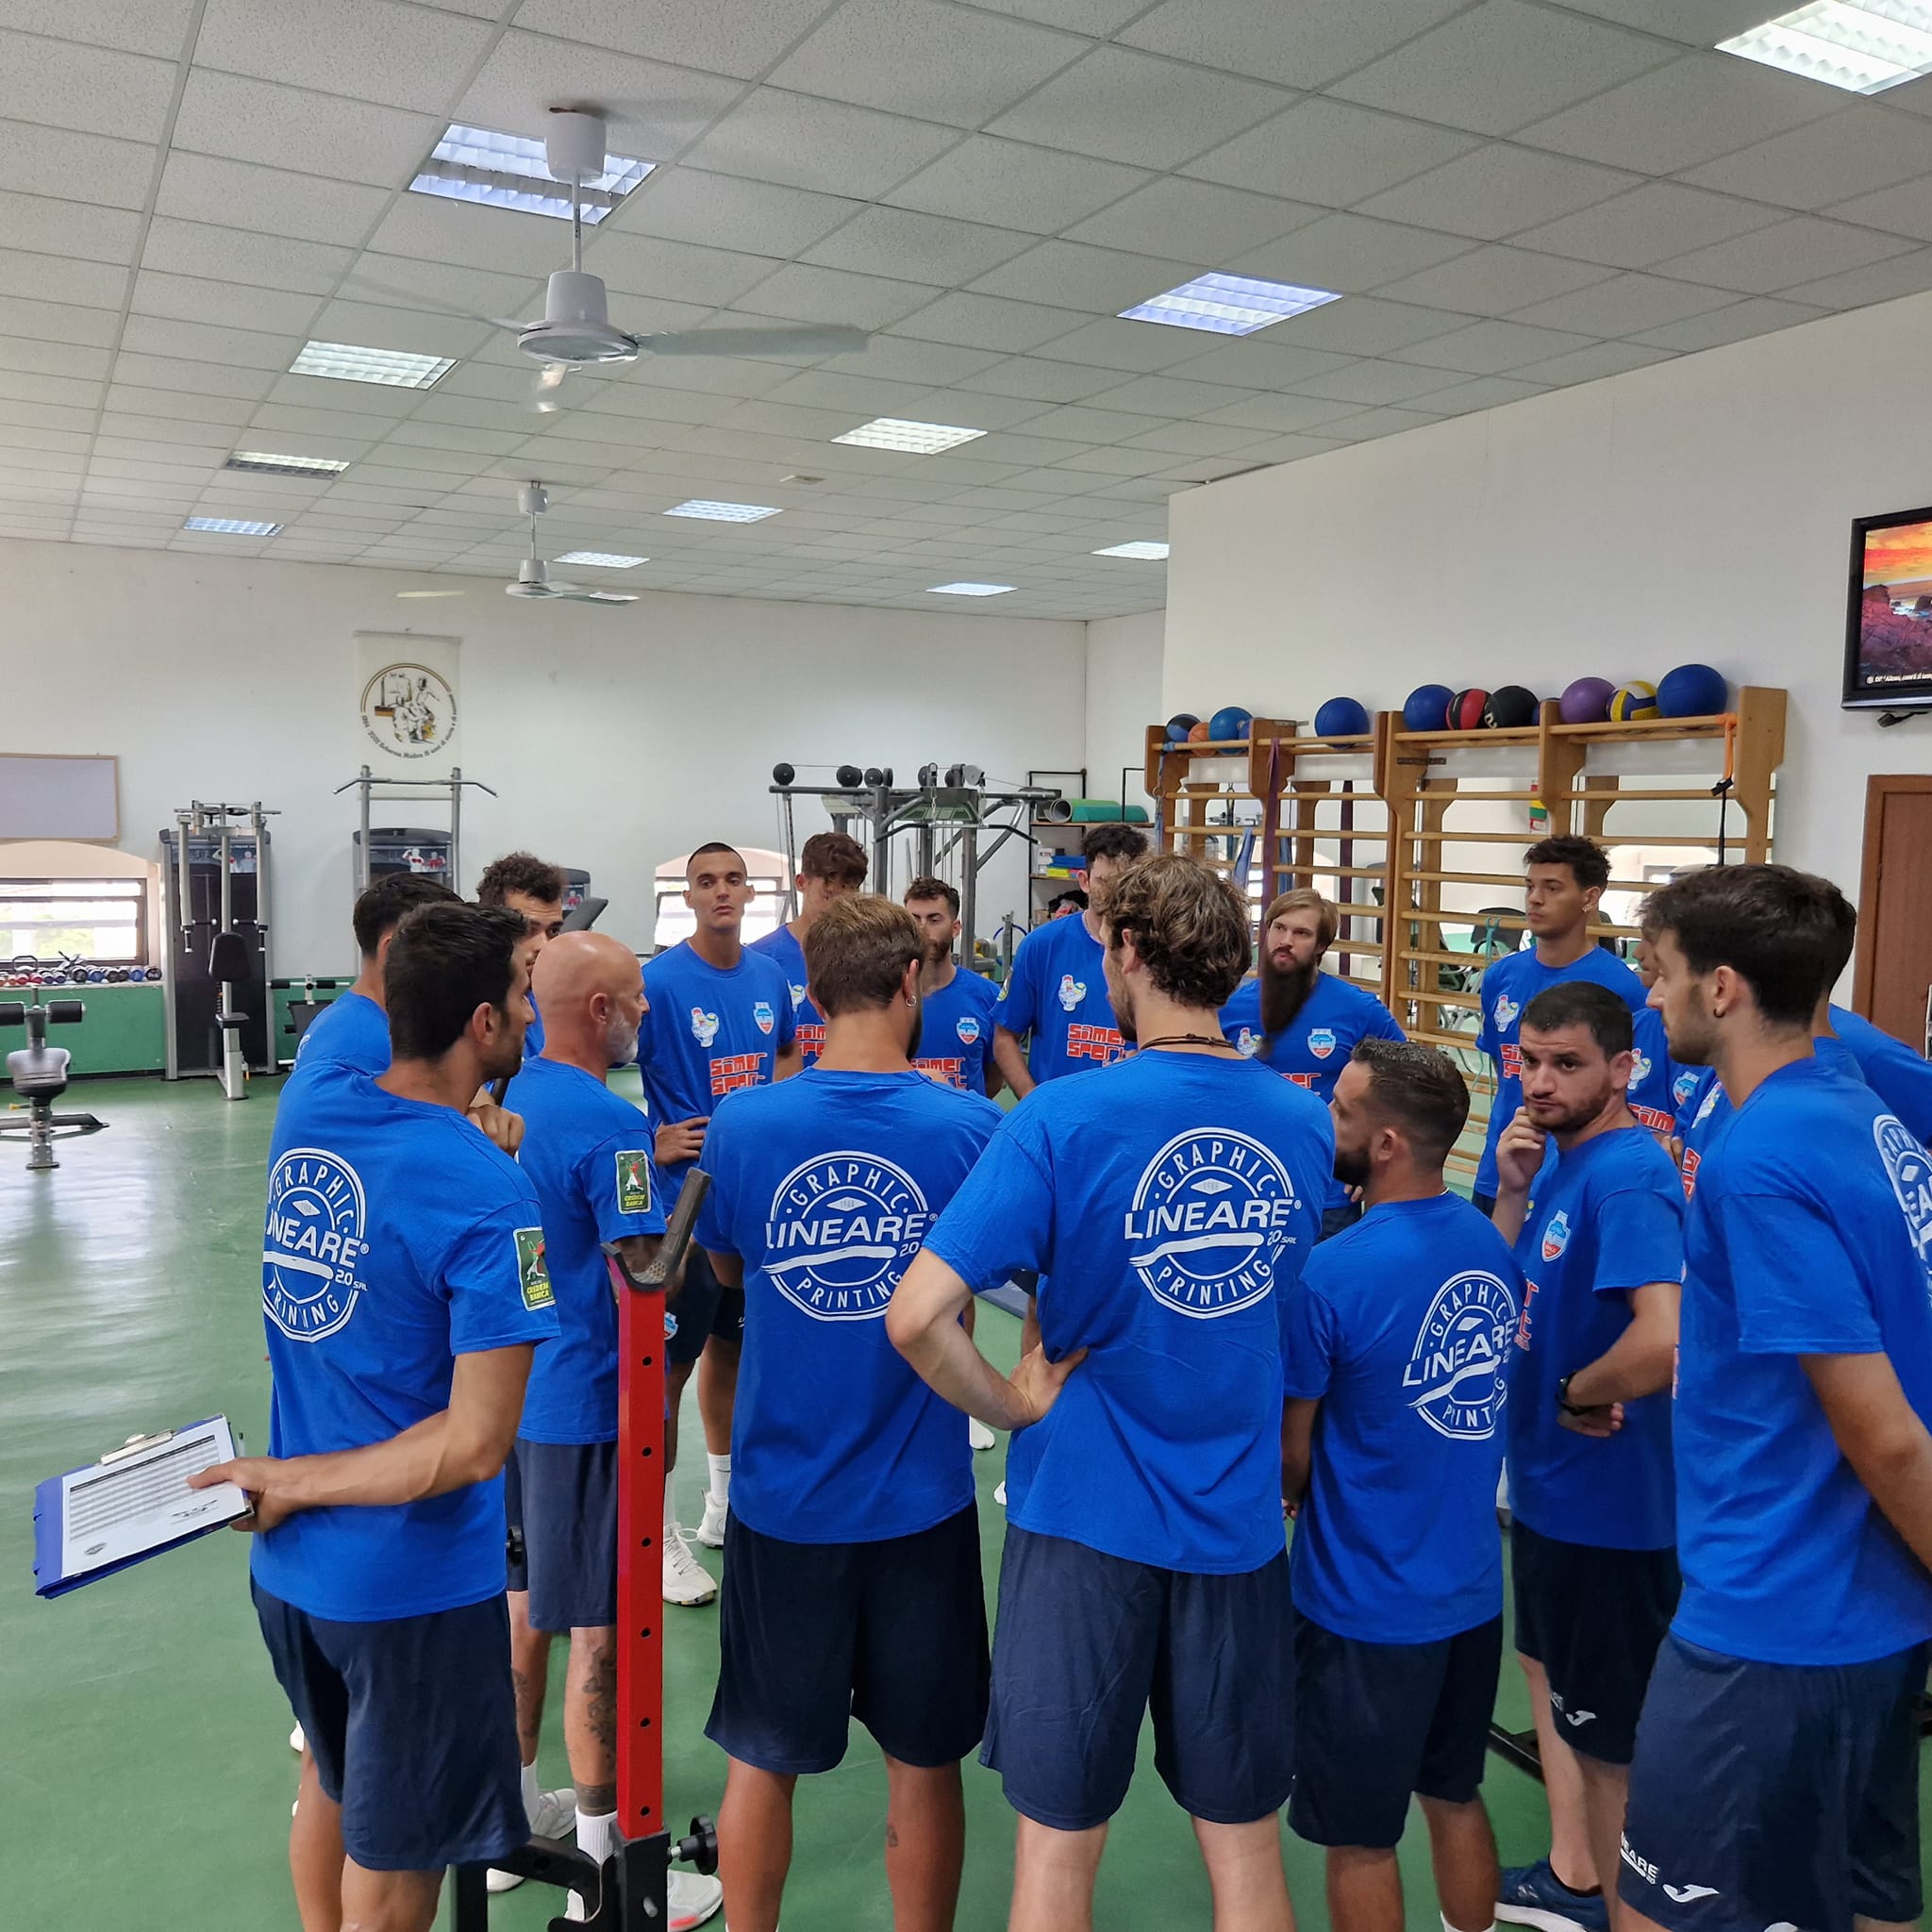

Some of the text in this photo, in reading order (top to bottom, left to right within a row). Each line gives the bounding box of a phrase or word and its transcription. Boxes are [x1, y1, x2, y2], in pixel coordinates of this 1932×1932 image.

[789, 1163, 909, 1209] GRAPHIC
[1158, 1141, 1276, 1191] GRAPHIC
[275, 1162, 354, 1225] GRAPHIC
[267, 1208, 361, 1269] INEARE
[765, 1213, 927, 1249] LINEARE
[1124, 1199, 1293, 1240] LINEARE
[268, 1276, 340, 1328] PRINING
[796, 1271, 903, 1308] PRINTING
[1157, 1259, 1271, 1305] PRINTING
[1430, 1284, 1507, 1338] GRAPHIC
[1402, 1318, 1516, 1387] LINEARE
[1442, 1376, 1506, 1426] PINTG
